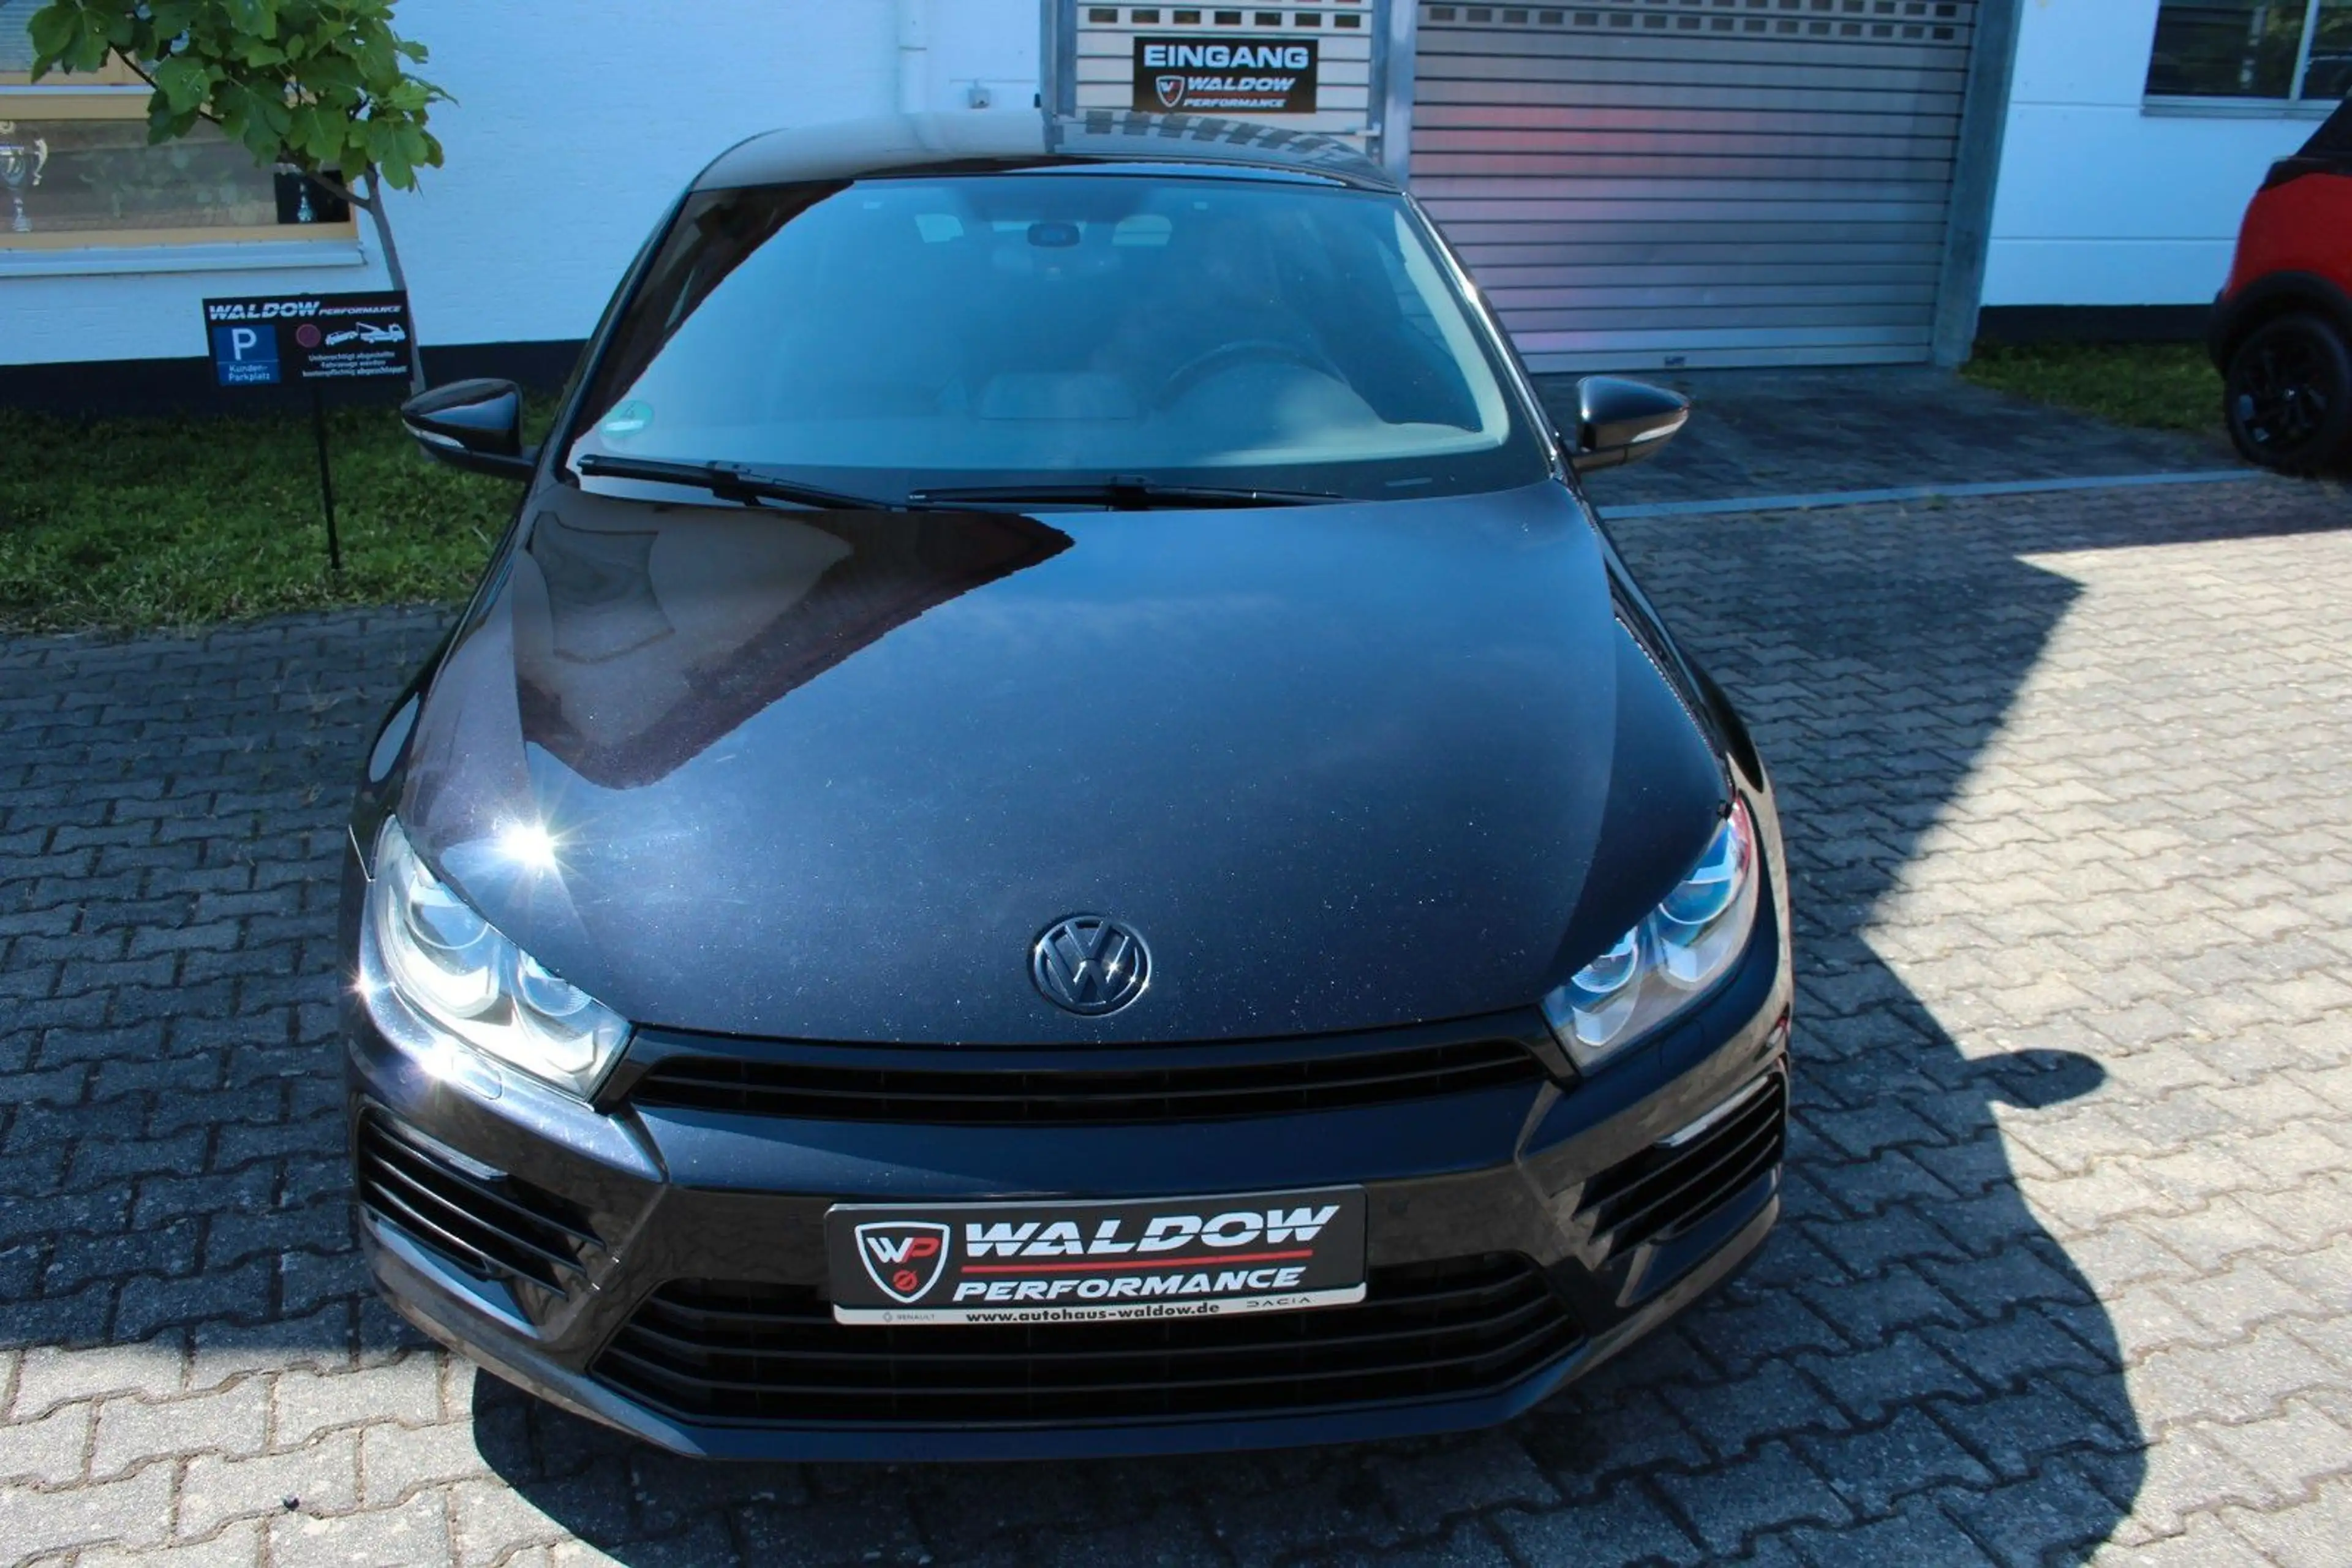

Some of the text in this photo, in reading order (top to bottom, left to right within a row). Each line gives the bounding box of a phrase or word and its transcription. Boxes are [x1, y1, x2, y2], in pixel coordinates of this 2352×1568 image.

[1144, 45, 1309, 69] EINGANG
[1188, 77, 1295, 91] WALDOW
[1183, 98, 1287, 107] PERFORMANCE
[209, 301, 401, 320] WALDOW PERFORMANCE
[232, 328, 257, 360] P
[228, 372, 270, 382] Parkplatz
[965, 1205, 1340, 1256] WALDOW
[952, 1267, 1306, 1302] PERFORMANCE
[966, 1302, 1219, 1322] www.autohaus-waldow.de
